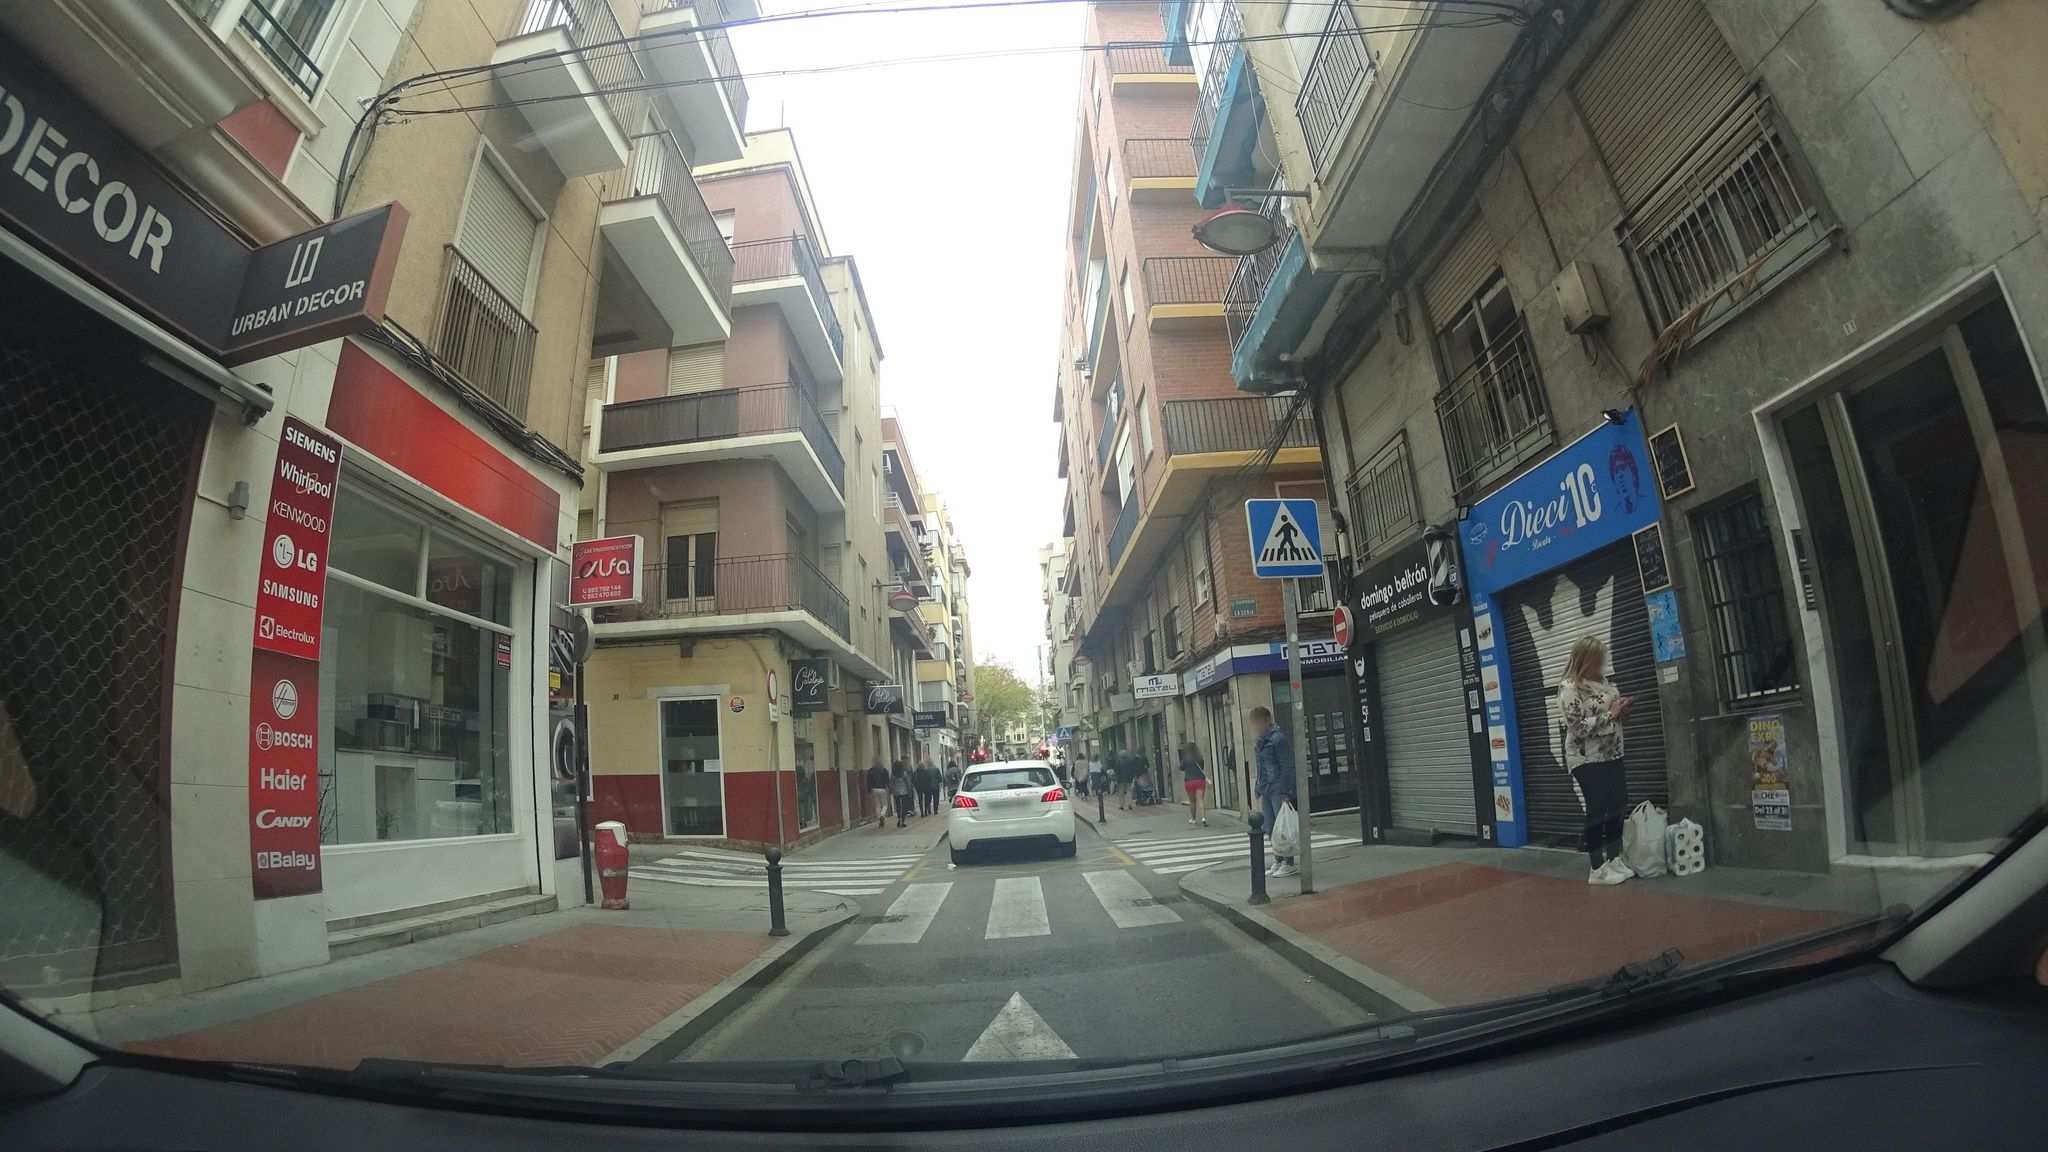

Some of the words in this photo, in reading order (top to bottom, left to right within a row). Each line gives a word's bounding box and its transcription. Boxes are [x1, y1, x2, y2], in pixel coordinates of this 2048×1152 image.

[231, 297, 292, 336] URBAN
[294, 279, 366, 316] DECOR
[285, 426, 336, 464] SIEMENS
[280, 459, 332, 499] Whirlpool
[272, 499, 326, 533] KENWOOD
[1501, 483, 1569, 551] Dieci
[297, 548, 318, 572] LG
[263, 579, 318, 608] SAMSUNG
[1360, 583, 1393, 610] domingo
[1393, 563, 1428, 593] beltrán
[275, 624, 315, 645] Electrolux
[1750, 720, 1780, 732] DINO
[274, 730, 313, 749] BOSCH
[261, 767, 307, 791] Haier
[255, 809, 313, 829] CANDY
[270, 852, 315, 870] Balay
